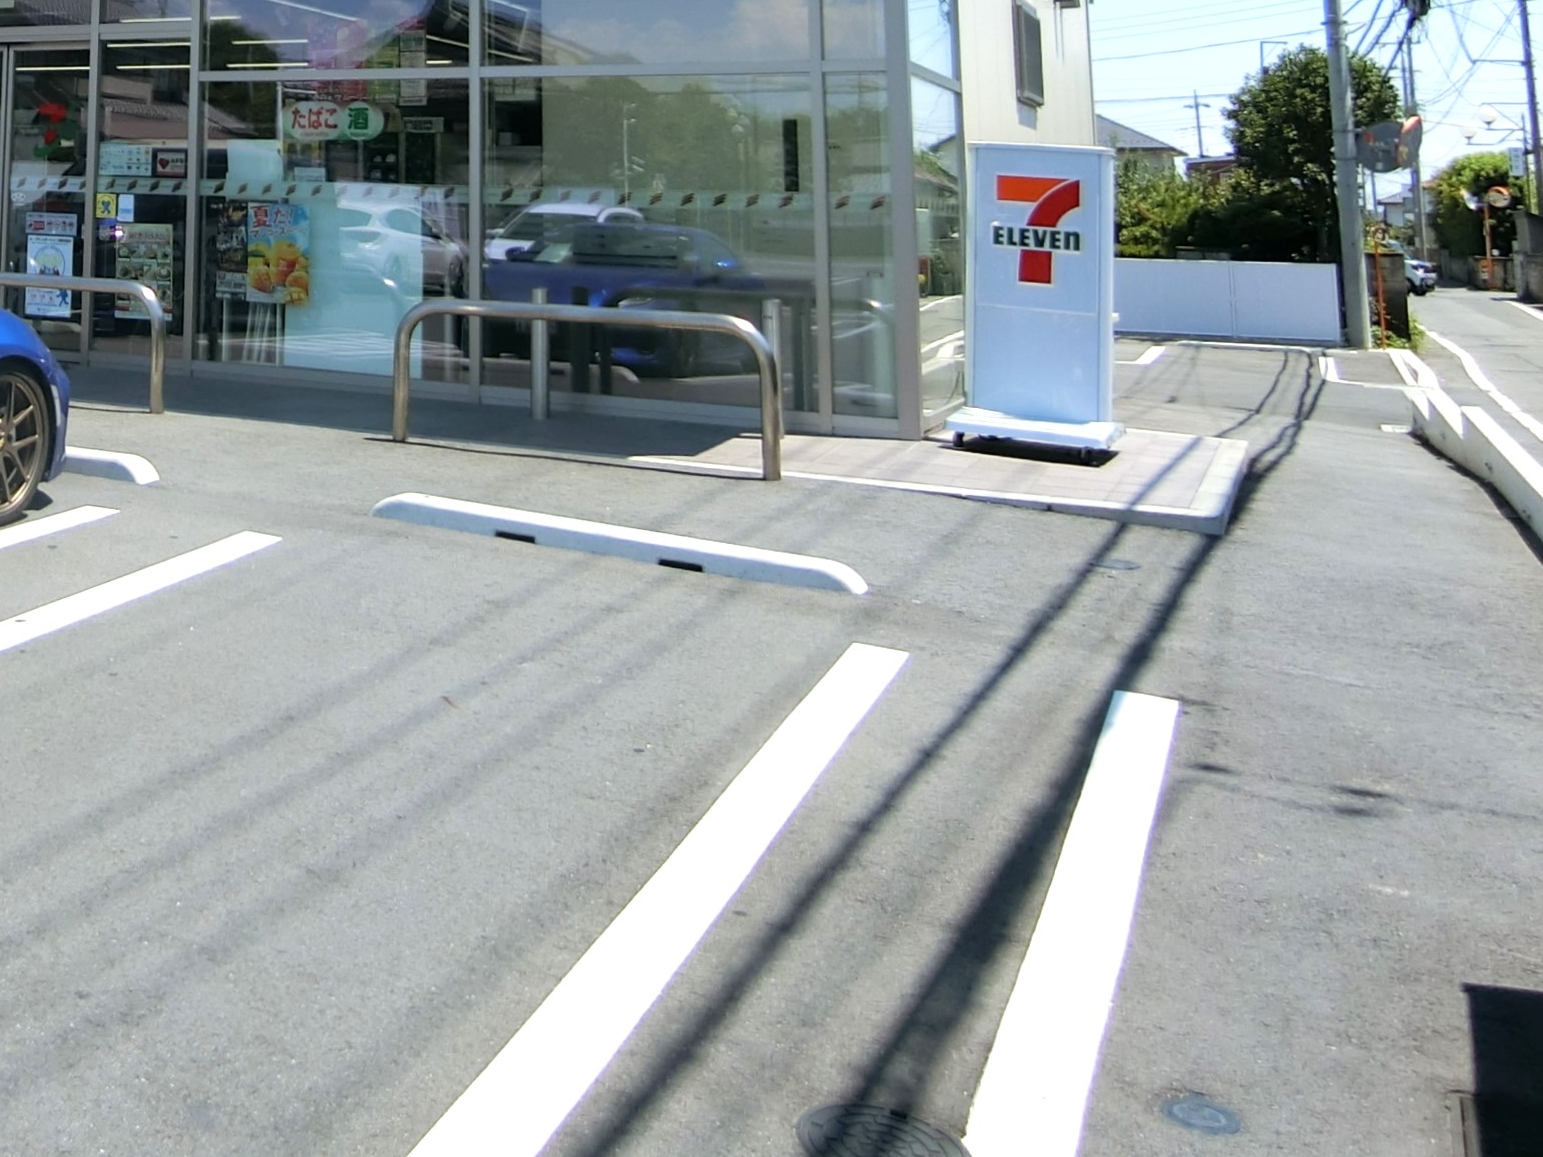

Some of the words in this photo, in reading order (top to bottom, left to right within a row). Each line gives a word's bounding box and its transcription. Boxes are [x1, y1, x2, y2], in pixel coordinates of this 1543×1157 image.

[291, 106, 339, 130] たばこ
[347, 106, 369, 131] 酒
[996, 175, 1080, 285] 7
